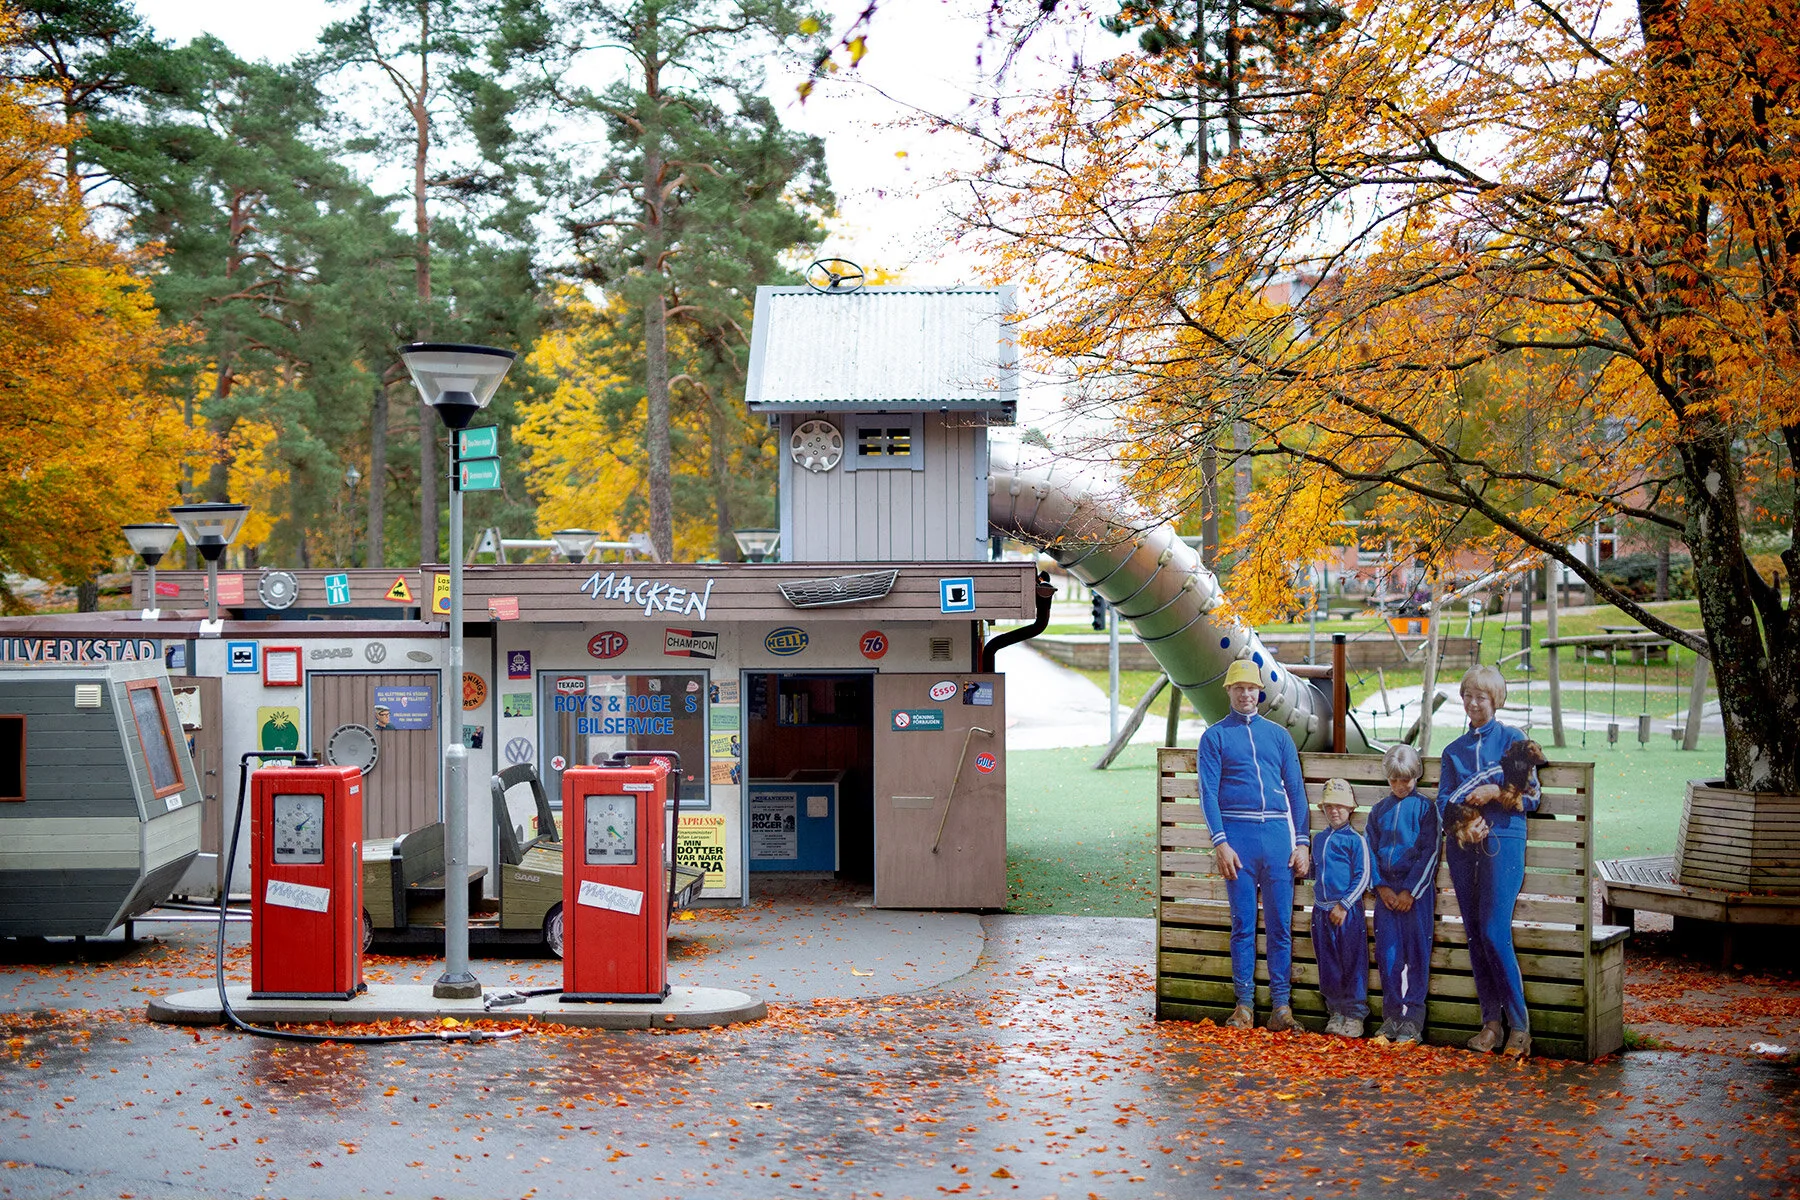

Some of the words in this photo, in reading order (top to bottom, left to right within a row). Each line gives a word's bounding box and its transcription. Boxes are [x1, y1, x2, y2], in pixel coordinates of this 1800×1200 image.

[580, 571, 715, 621] MACKEN
[593, 633, 623, 655] STP
[667, 637, 715, 650] CHAMPION
[766, 633, 809, 648] HELLA
[863, 636, 884, 652] 76
[0, 639, 156, 661] ILVERKSTAD
[310, 647, 354, 660] SAAB
[558, 681, 585, 689] TEXACO
[554, 695, 602, 712] ROY'S
[607, 695, 621, 712] &
[625, 695, 671, 712] ROGE
[577, 717, 674, 735] BILSERVICE
[976, 756, 996, 769] GULF
[752, 813, 772, 821] ROY
[774, 813, 782, 821] &
[752, 821, 782, 829] ROGER
[514, 872, 540, 882] SAAB
[268, 882, 329, 911] MACKEN
[581, 883, 642, 912] MACKEN
